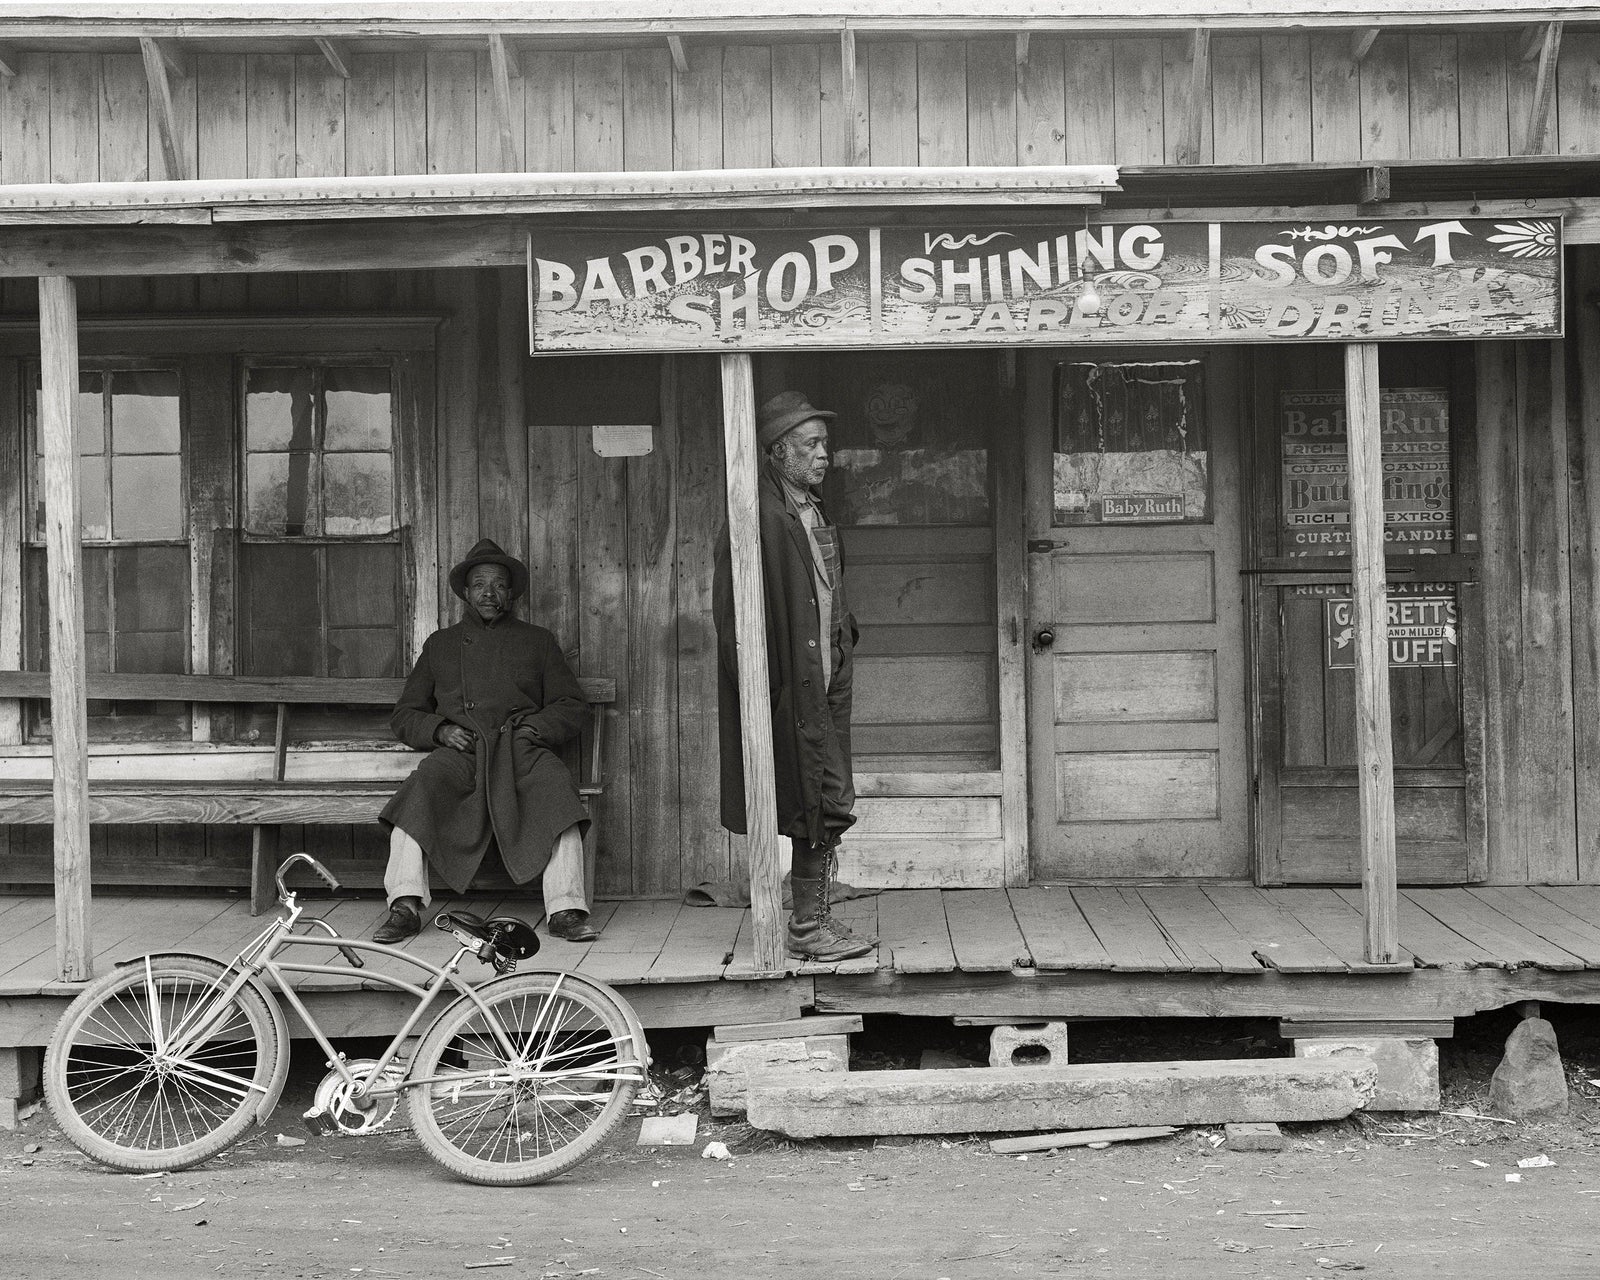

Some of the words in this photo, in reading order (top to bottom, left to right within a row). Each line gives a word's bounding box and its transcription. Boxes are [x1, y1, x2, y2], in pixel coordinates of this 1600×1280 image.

[900, 225, 1164, 304] SHINING
[1254, 220, 1473, 288] SOFT
[535, 234, 761, 312] BARBER
[669, 234, 859, 340] SHOP
[928, 290, 1186, 333] PARLOR
[1382, 408, 1449, 435] Rut
[1294, 444, 1334, 454] RICH
[1291, 464, 1347, 474] CURTI
[1104, 499, 1143, 516] Baby
[1145, 498, 1182, 514] Ruth
[1294, 514, 1335, 524] RICH
[1385, 511, 1455, 522] EXTROS
[1295, 532, 1351, 544] CURTI
[1384, 530, 1456, 542] CANDIE
[1296, 584, 1336, 595] RICH
[1386, 582, 1456, 593] EXTROS
[1334, 600, 1457, 626] GRETT'S
[1388, 628, 1407, 637] AND
[1408, 626, 1447, 638] MILDER
[1392, 640, 1443, 663] UFF
